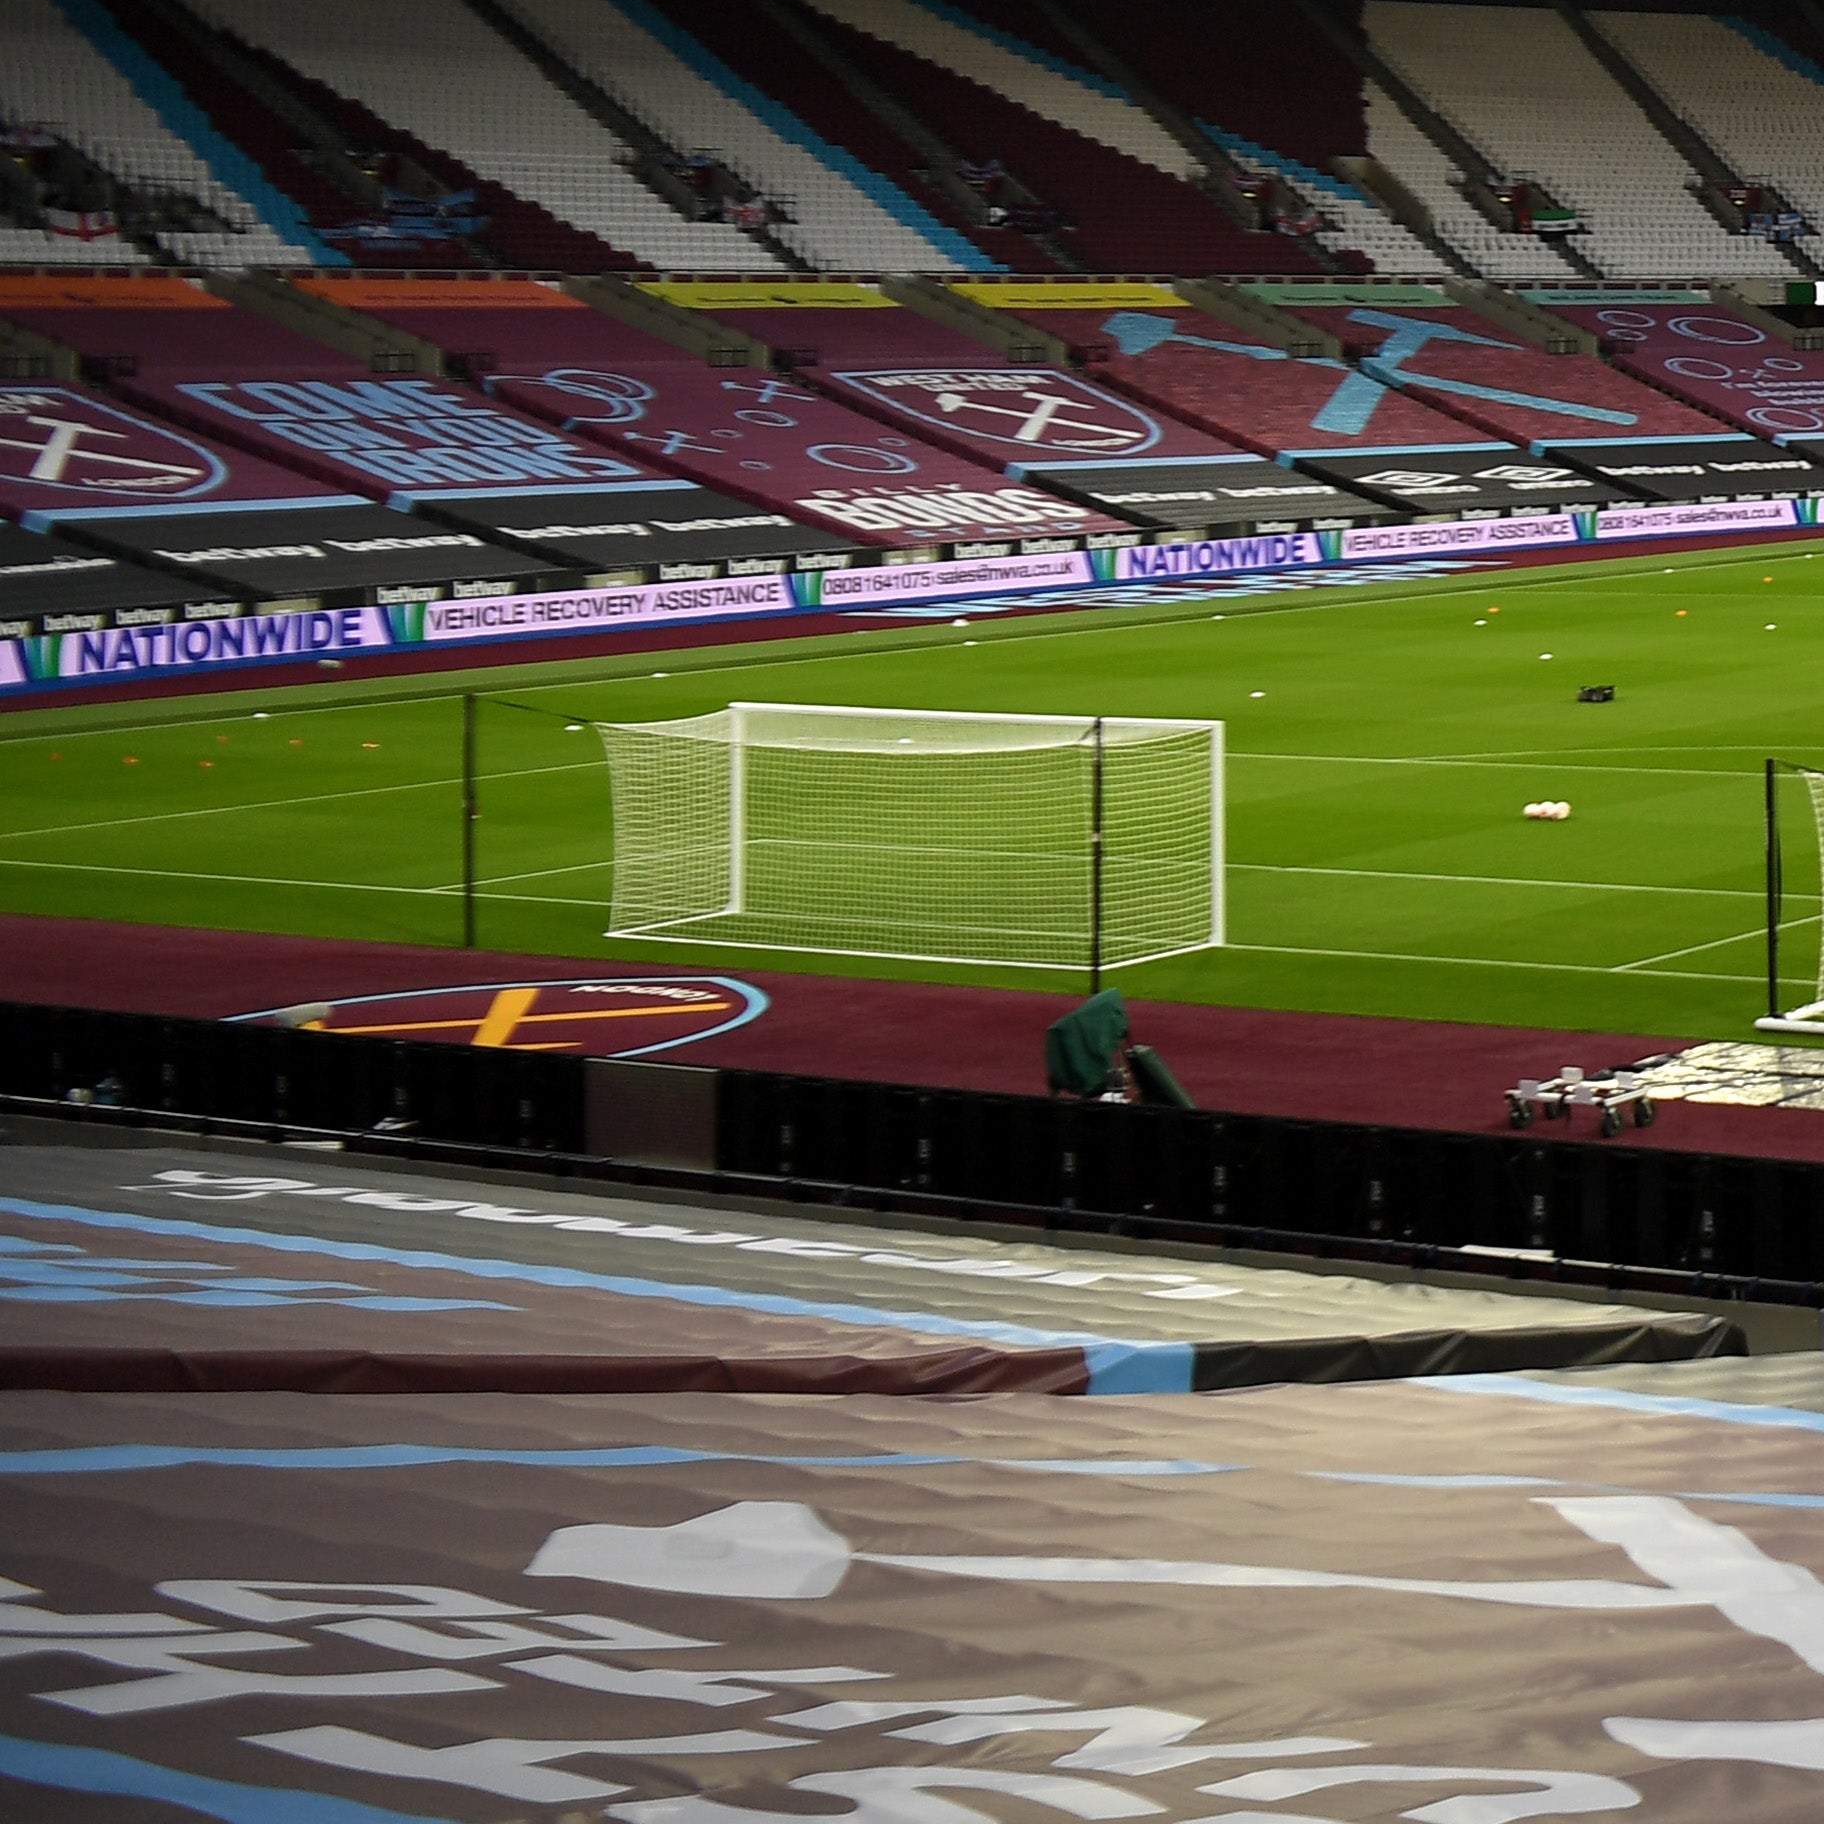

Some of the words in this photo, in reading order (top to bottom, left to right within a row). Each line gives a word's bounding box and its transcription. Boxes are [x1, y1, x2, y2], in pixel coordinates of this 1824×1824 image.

[175, 381, 500, 421] COME
[260, 420, 410, 450] ON
[376, 418, 562, 446] YOU
[326, 443, 645, 484] IRONS
[811, 483, 963, 499] BILLY
[793, 489, 1090, 531] BONDS
[1675, 505, 1784, 526] sales@nwva.co.uk
[496, 521, 654, 540] betway
[648, 514, 796, 533] betway
[902, 521, 1086, 538] STAND
[1346, 532, 1405, 553] VEHICLE
[1409, 526, 1483, 549] RECOVERY
[1487, 519, 1571, 543] ASSISTANCE
[154, 543, 328, 564] betway
[322, 533, 488, 552] betway
[1129, 534, 1306, 579] NATIONWIDE
[822, 570, 931, 596] 08081641075
[935, 557, 1074, 586] sales@nwva.co.uk
[377, 585, 441, 604] betway
[428, 601, 527, 633] VEHICLE
[530, 592, 647, 624] RECOVERY
[651, 582, 780, 614] ASSISTANCE
[44, 614, 103, 632] betway
[115, 608, 171, 625] betway
[184, 602, 241, 619] betway
[0, 619, 28, 638] way
[80, 608, 363, 672] NATIONWIDE
